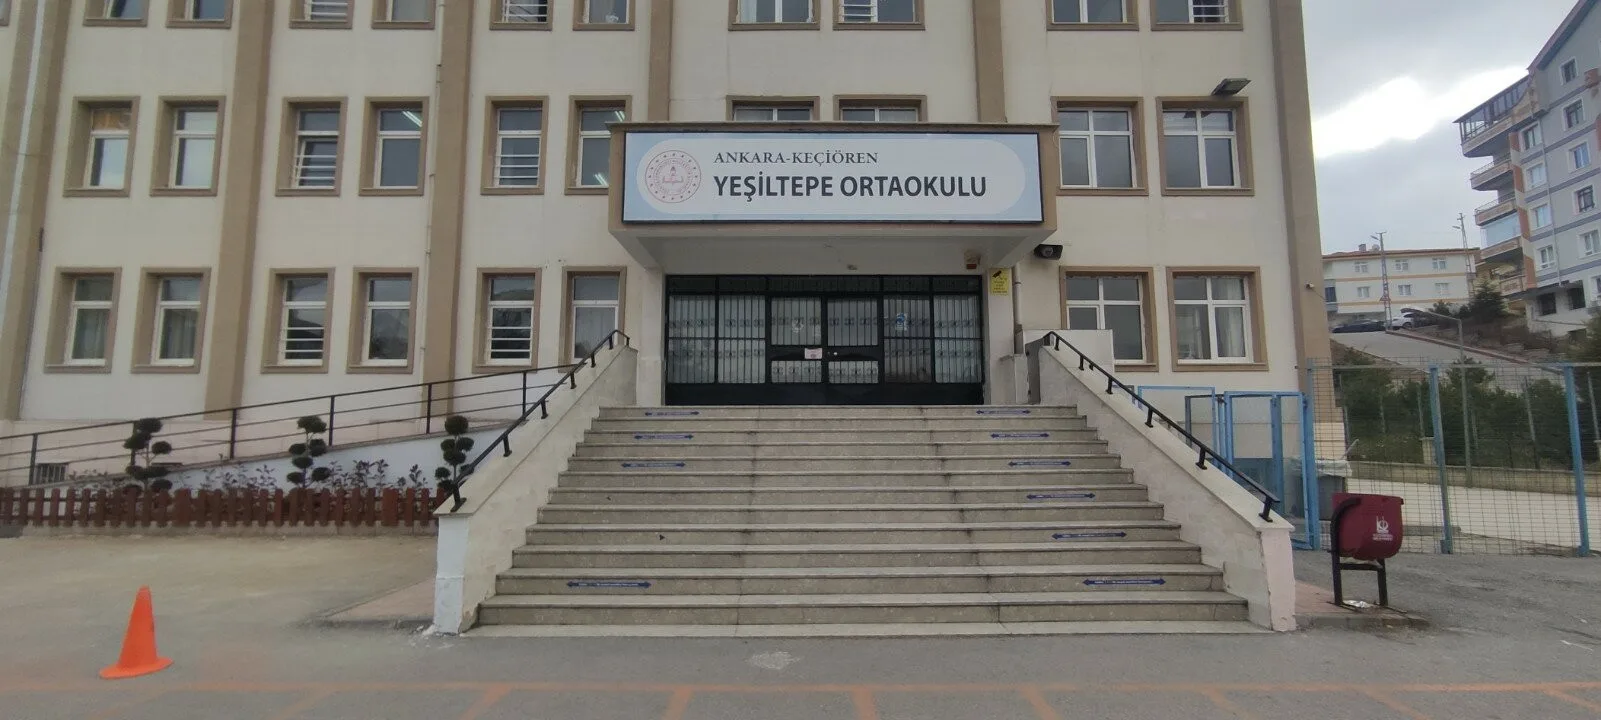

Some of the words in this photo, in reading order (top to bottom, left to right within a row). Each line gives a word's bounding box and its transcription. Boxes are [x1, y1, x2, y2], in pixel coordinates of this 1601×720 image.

[713, 149, 879, 167] ANKARA-KEÇİÖREN
[713, 171, 834, 202] YEŞİLTEPE
[840, 175, 988, 198] ORTAOKULU
